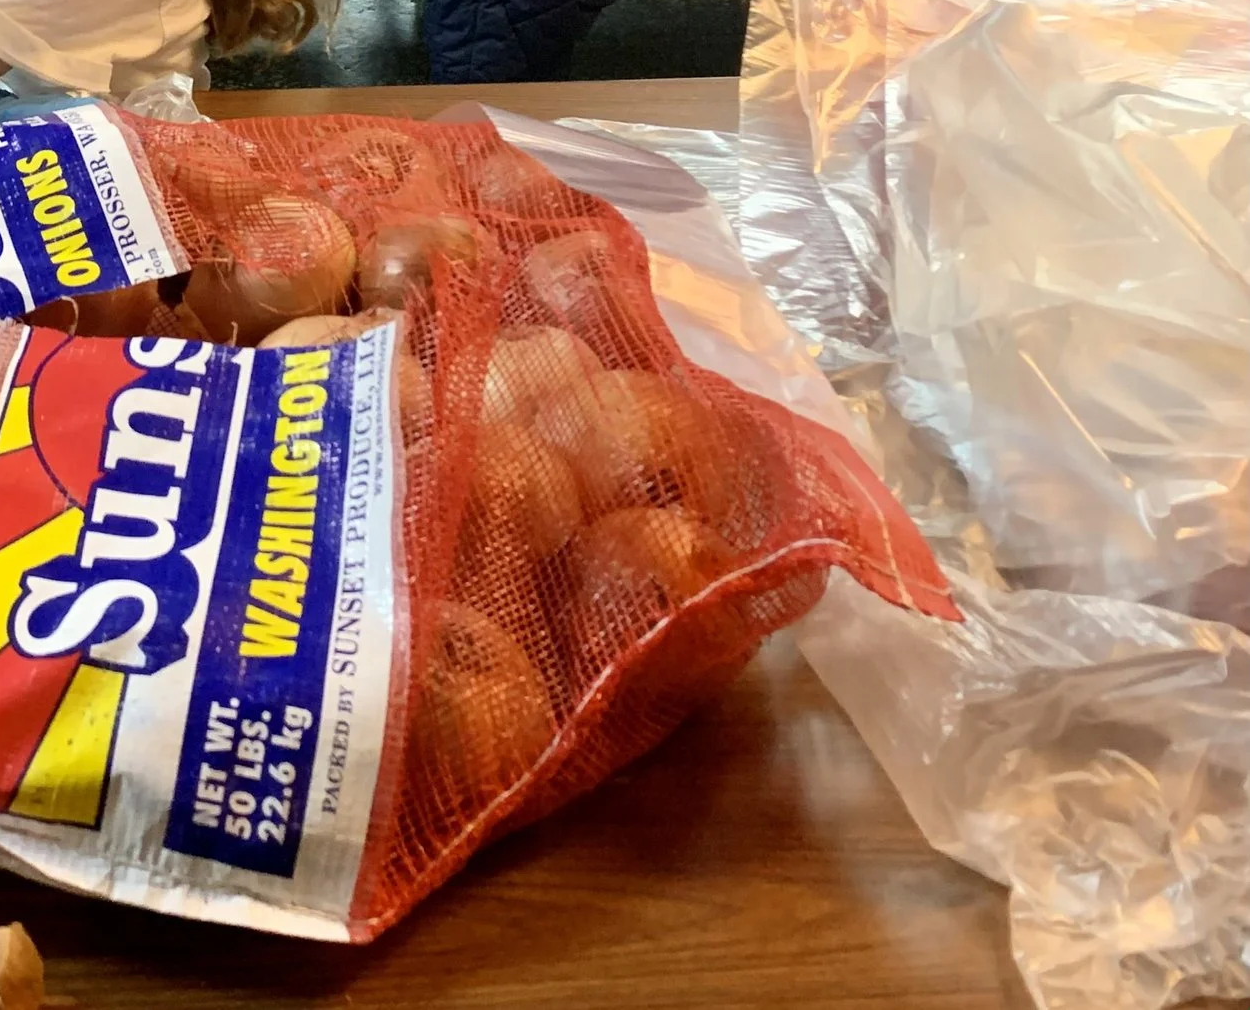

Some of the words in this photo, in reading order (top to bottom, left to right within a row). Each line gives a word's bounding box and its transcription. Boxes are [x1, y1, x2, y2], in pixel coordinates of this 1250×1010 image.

[75, 124, 98, 149] WA
[15, 148, 101, 287] ONIONS
[89, 149, 144, 265] PROSSER,
[239, 349, 332, 658] WASHINGTON
[346, 384, 376, 546] PRODUCE,
[331, 557, 366, 677] SUNSET
[203, 697, 240, 753] WT.
[270, 705, 313, 751] kg
[338, 684, 355, 714] BY
[233, 710, 272, 781] LBS.
[321, 719, 350, 815] PACKED
[192, 762, 228, 828] NET
[224, 790, 257, 840] 50
[257, 761, 297, 846] 22.6
